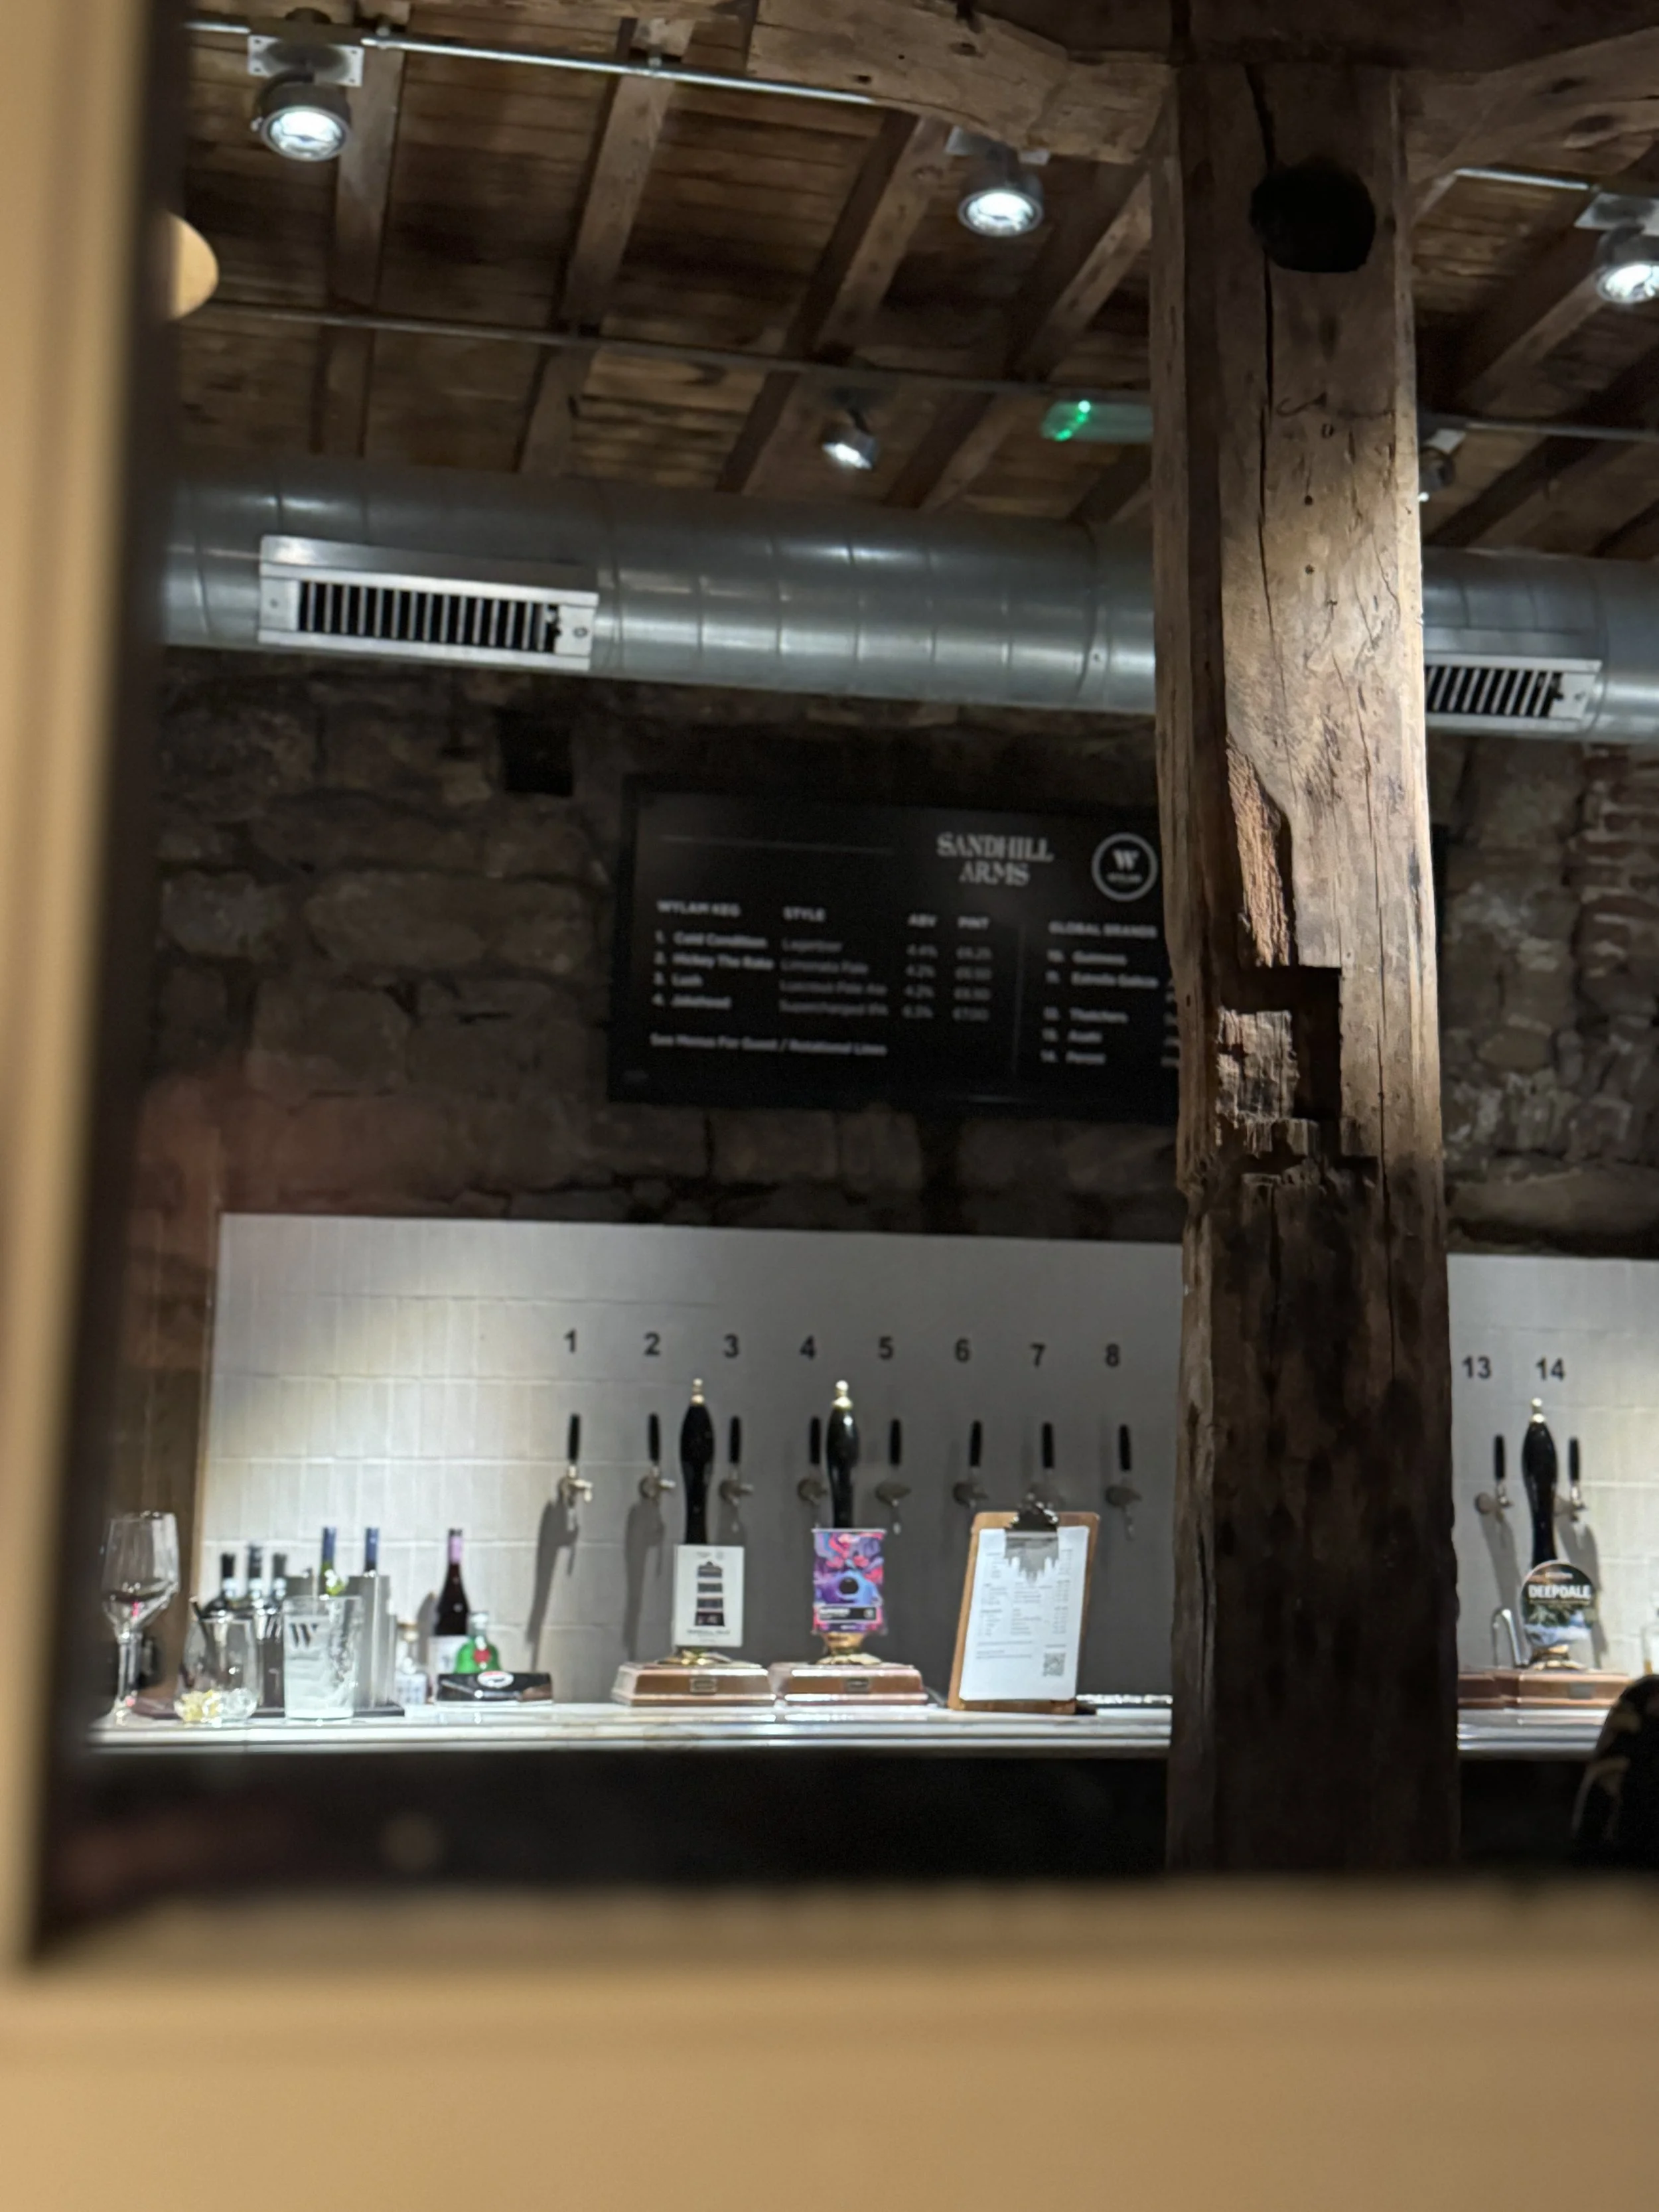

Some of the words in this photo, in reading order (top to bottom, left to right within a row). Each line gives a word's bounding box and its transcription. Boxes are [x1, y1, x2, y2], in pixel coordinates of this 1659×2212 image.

[937, 832, 1054, 863] SANDHILL
[960, 860, 1031, 886] ARMS
[783, 906, 826, 922] STYLE
[1048, 921, 1102, 936] GLOBAL
[1102, 923, 1157, 938] BRANDS
[565, 1329, 576, 1353] 1
[644, 1333, 660, 1357] 2
[725, 1334, 739, 1359] 3
[800, 1336, 816, 1359] 4
[879, 1337, 893, 1361] 5
[955, 1339, 970, 1363] 6
[1031, 1343, 1045, 1367] 7
[1105, 1343, 1120, 1368] 8
[1462, 1356, 1491, 1379] 13
[1536, 1358, 1565, 1380] 14
[1528, 1584, 1592, 1600] DEEPDALE
